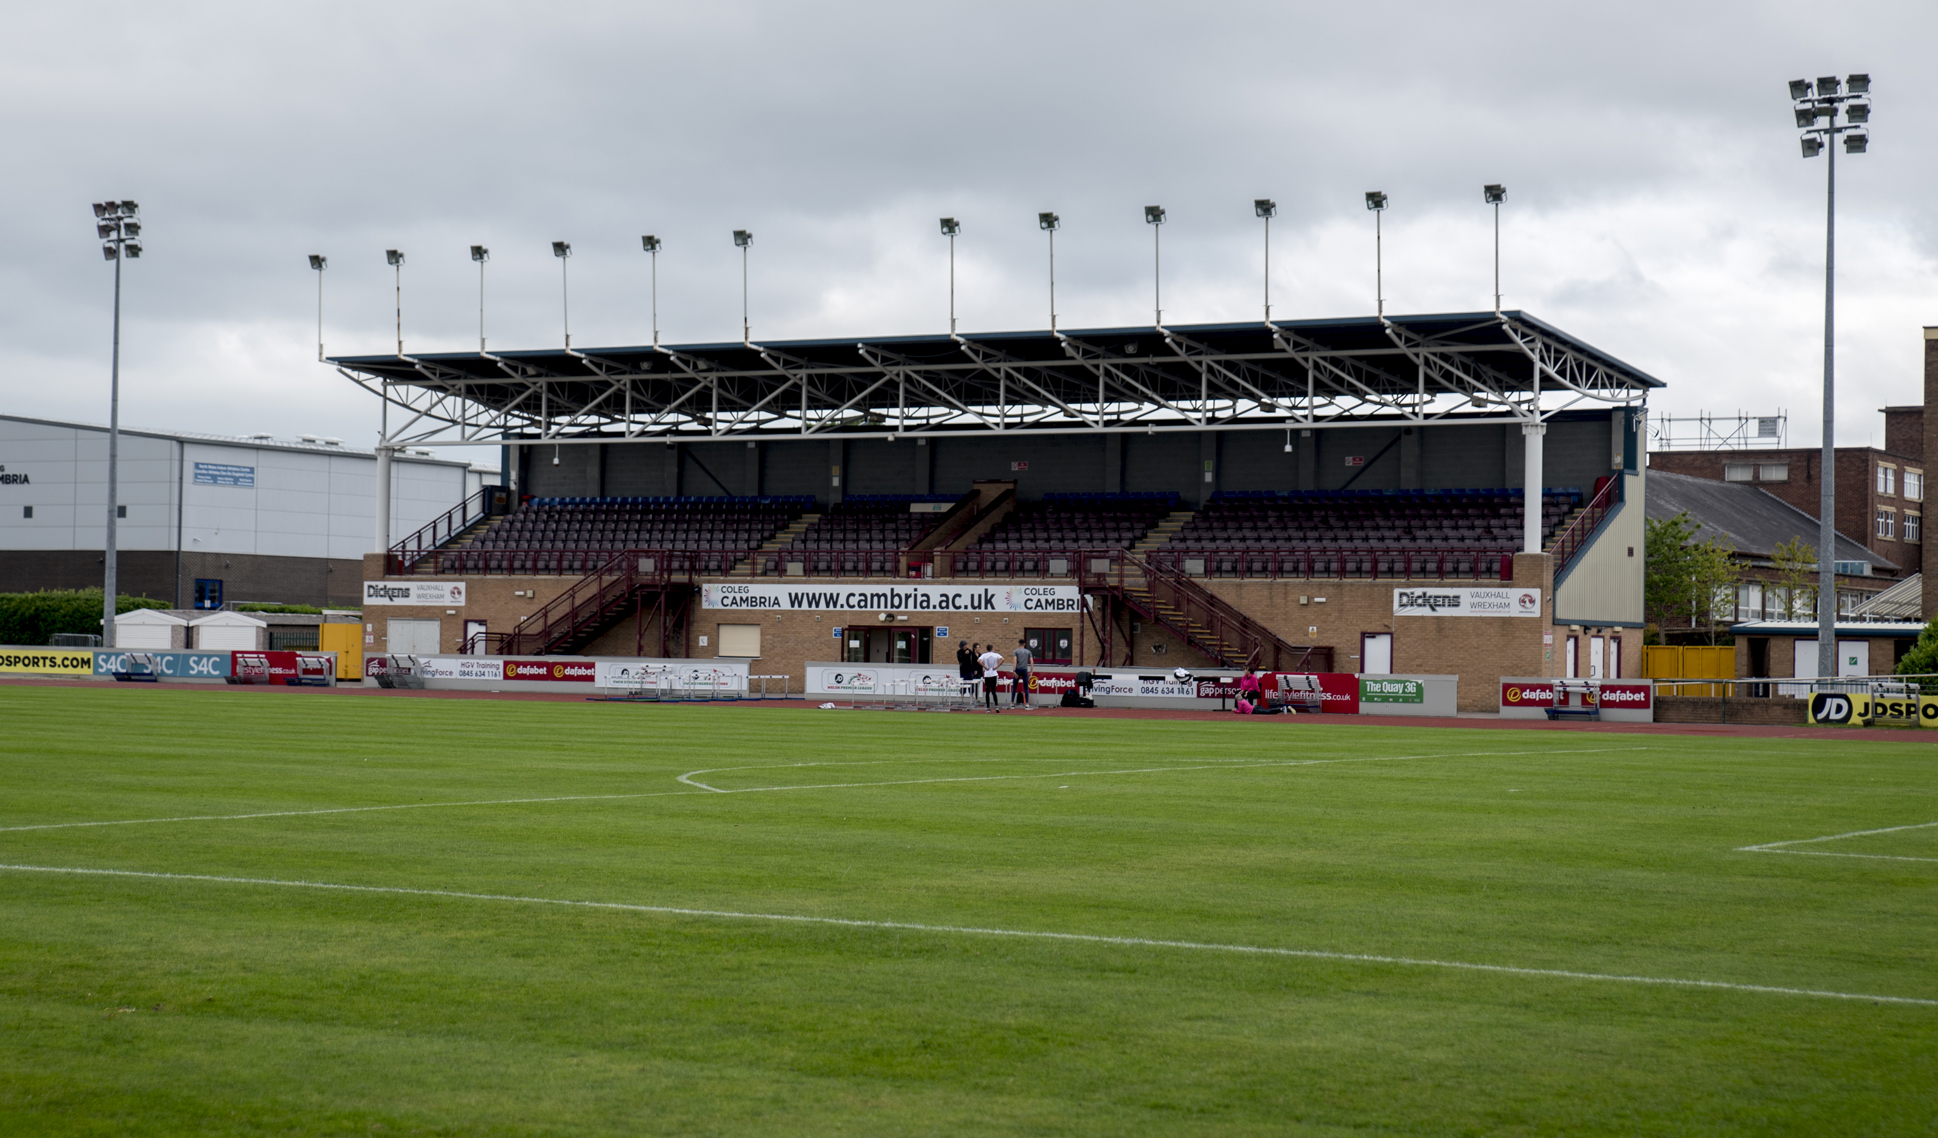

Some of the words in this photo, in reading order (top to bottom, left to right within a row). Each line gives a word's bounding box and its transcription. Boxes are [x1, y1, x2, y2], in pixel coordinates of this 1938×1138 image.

[367, 584, 411, 602] Dickens
[720, 585, 749, 593] COLEG
[1023, 587, 1056, 596] COLEG
[788, 588, 996, 611] www.cambria.ac.uk
[1398, 590, 1461, 612] Dickens
[1469, 591, 1511, 600] VAUXHALL
[720, 596, 781, 608] CAMBRIA
[1023, 597, 1081, 611] CAMBRI
[1469, 601, 1511, 610] WREXHAM
[98, 654, 127, 673] S4C
[189, 655, 220, 675] S4C
[476, 662, 500, 671] Training
[488, 670, 501, 678] 1161
[517, 665, 547, 676] dafabet
[564, 666, 595, 677] dafabet
[1040, 676, 1076, 688] dafabet
[1365, 681, 1381, 692] The
[1382, 681, 1404, 694] Quay
[1405, 682, 1417, 693] 3G
[1140, 686, 1159, 695] 0845
[1161, 687, 1174, 695] 634
[1522, 689, 1564, 701] dafabt
[1601, 690, 1645, 702] dafabet
[1816, 698, 1849, 720] JD
